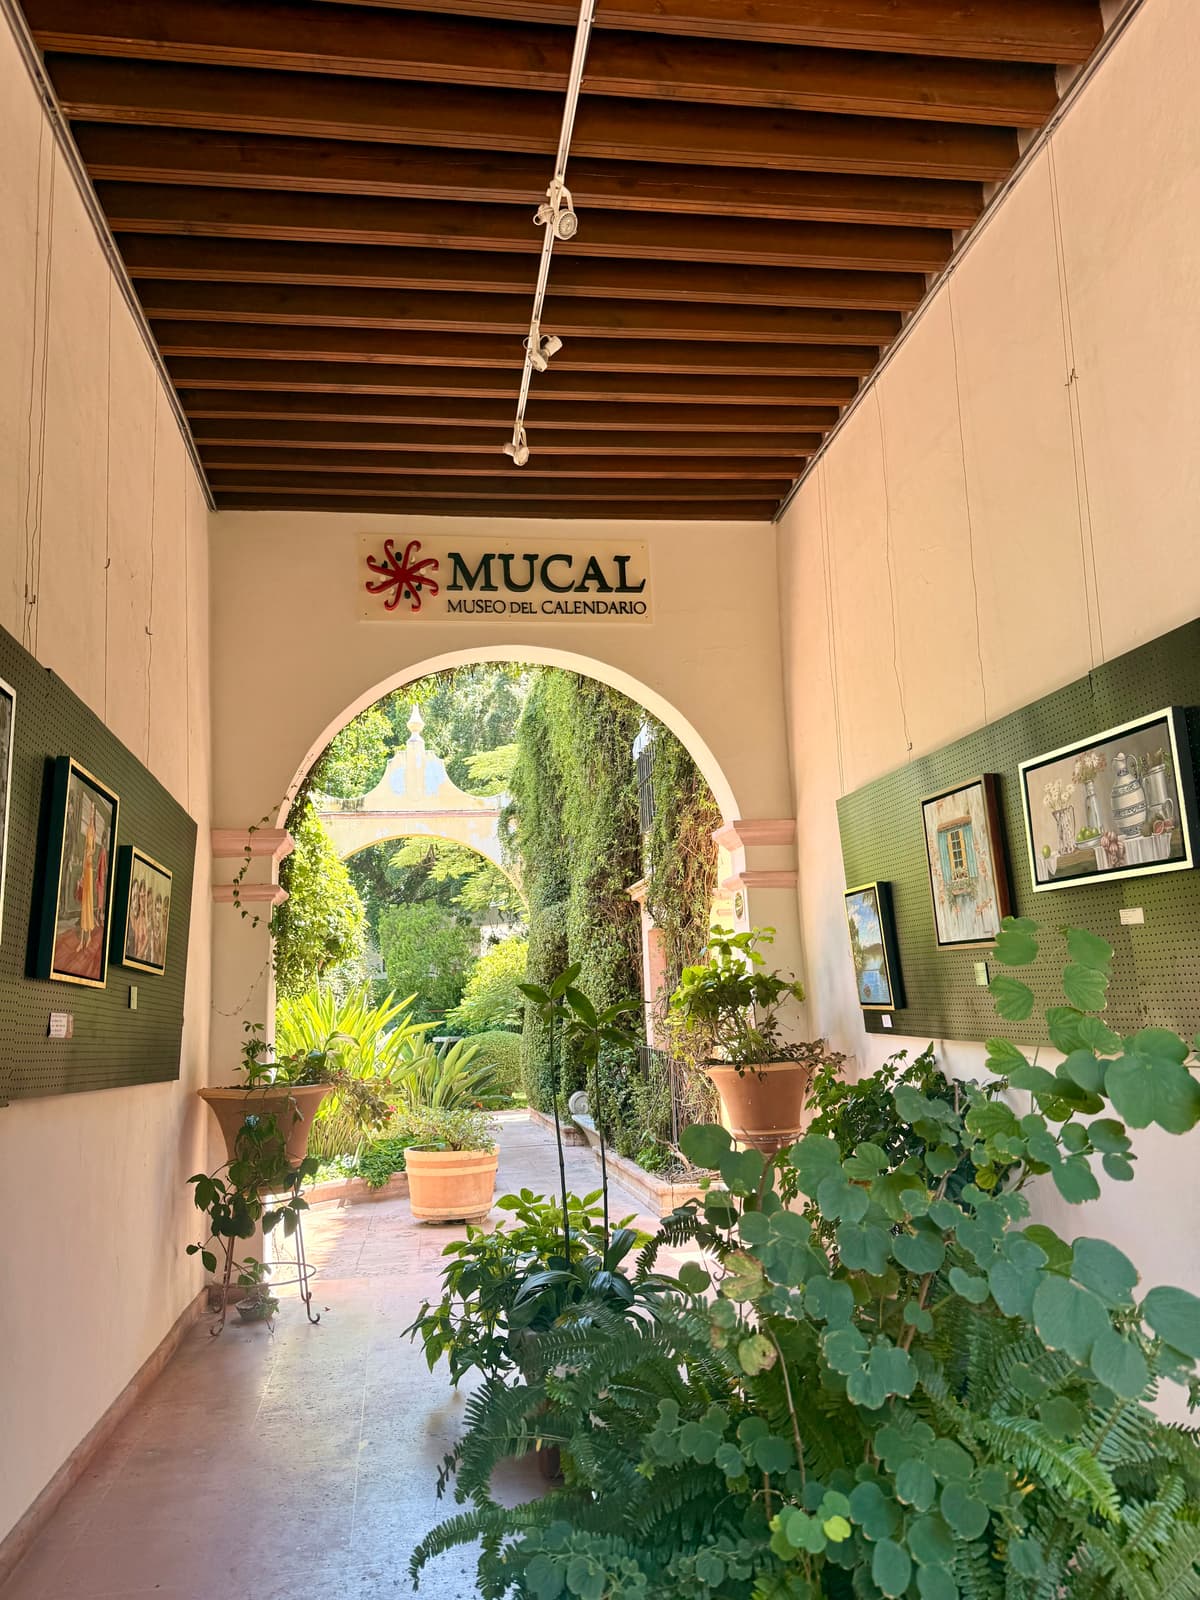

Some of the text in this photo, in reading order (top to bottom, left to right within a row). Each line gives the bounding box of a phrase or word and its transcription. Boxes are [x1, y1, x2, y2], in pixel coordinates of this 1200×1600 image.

[446, 552, 646, 593] MUCAL
[447, 599, 647, 615] MUSEO DEL CALENDARIO
